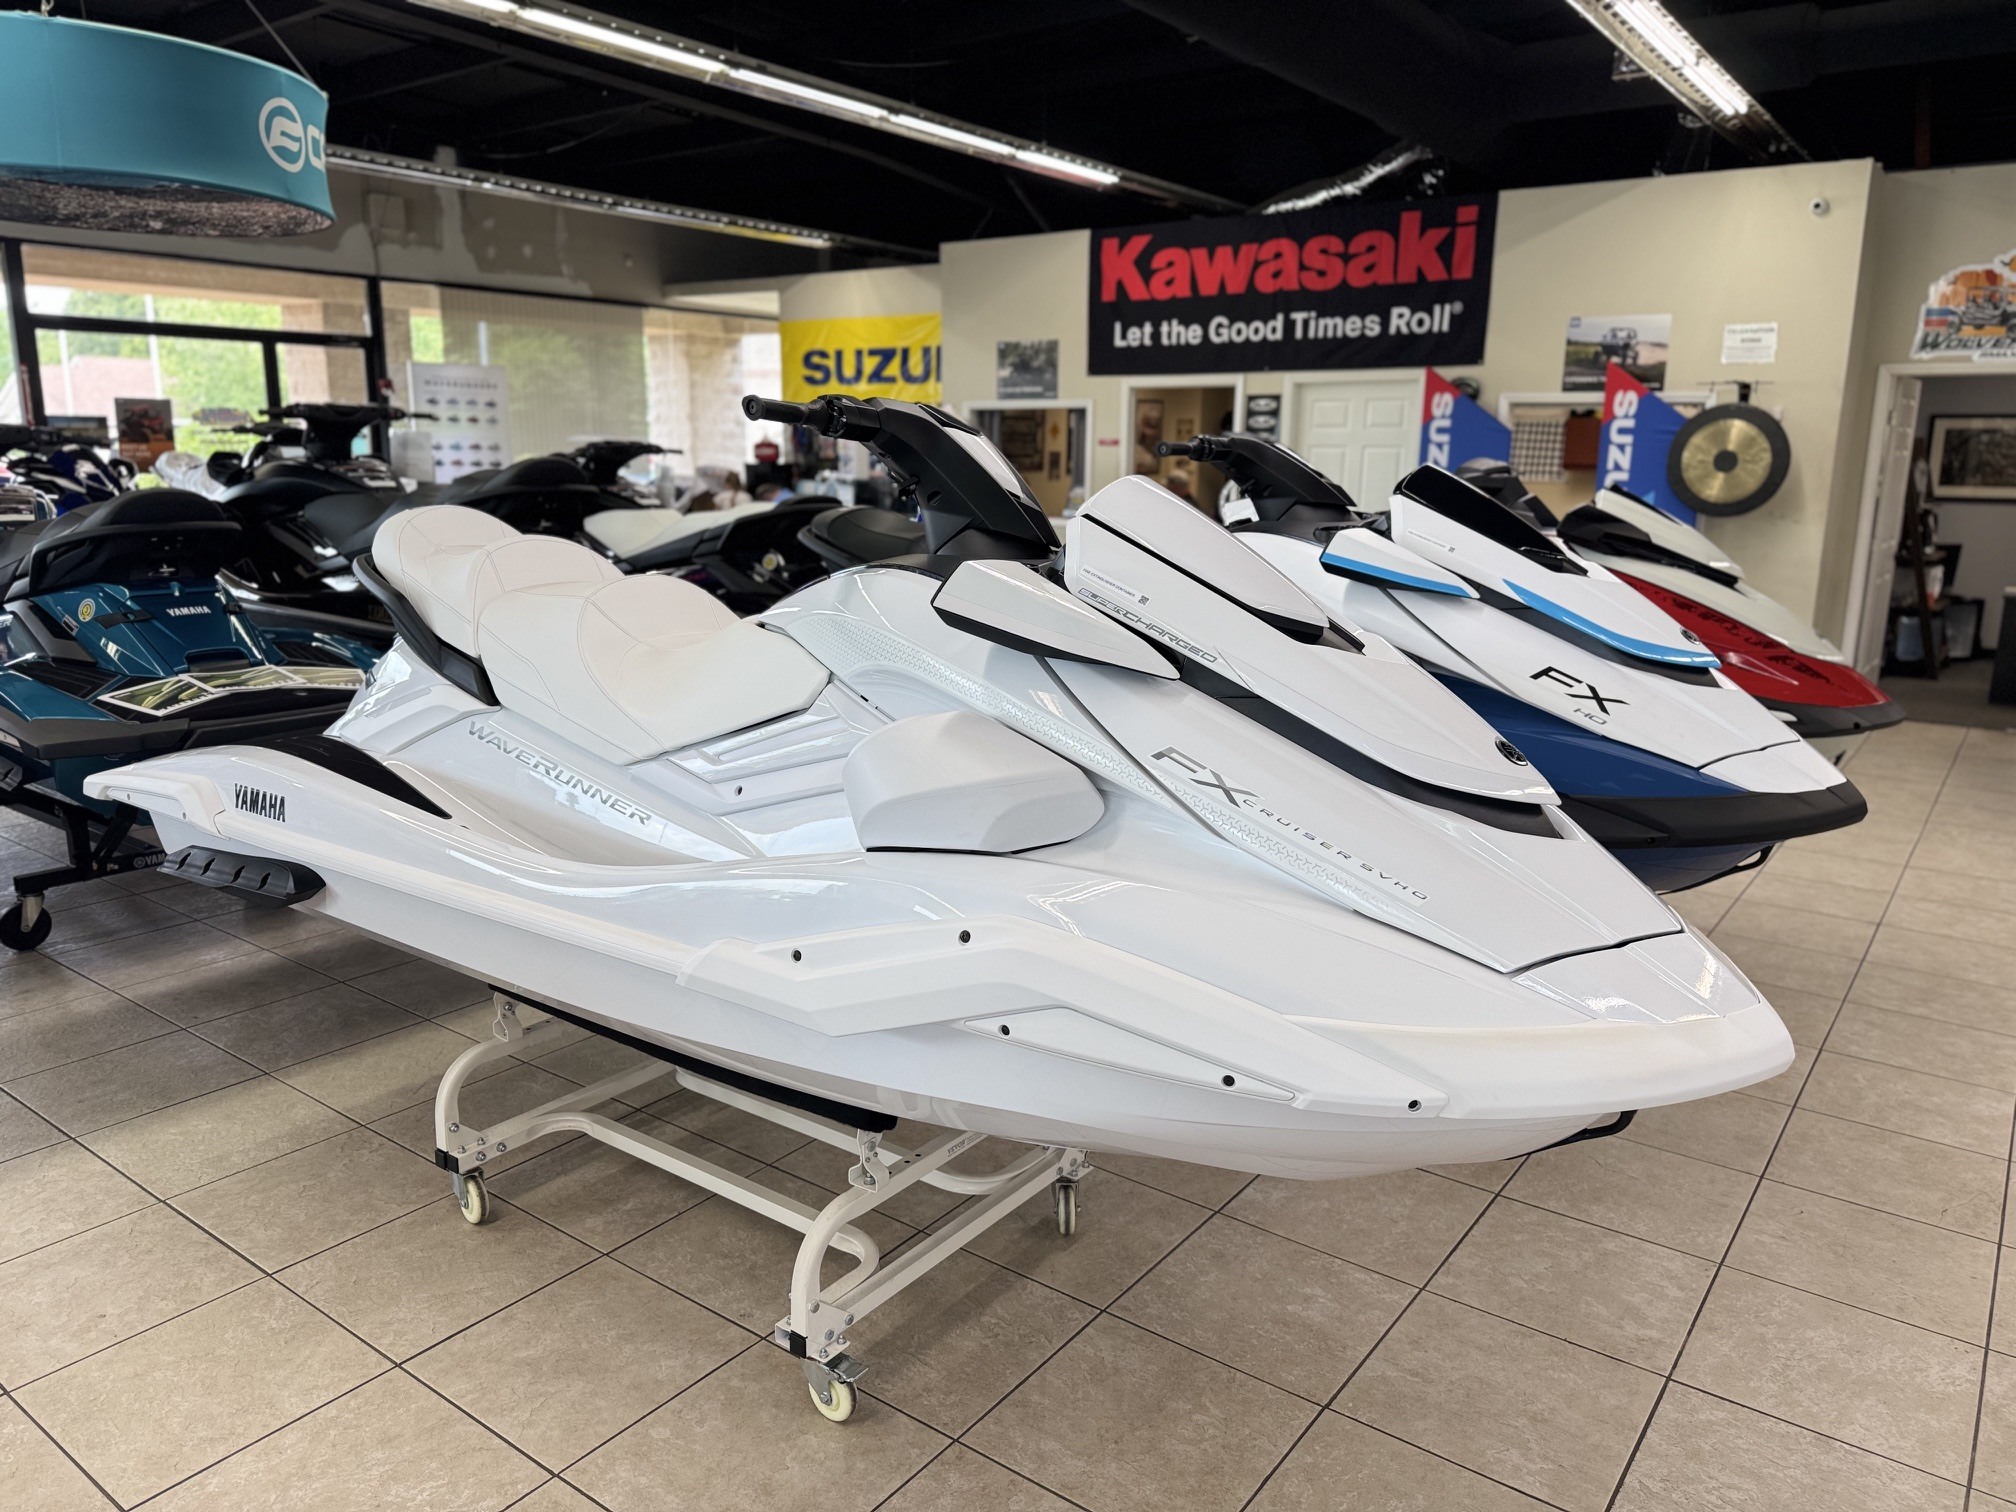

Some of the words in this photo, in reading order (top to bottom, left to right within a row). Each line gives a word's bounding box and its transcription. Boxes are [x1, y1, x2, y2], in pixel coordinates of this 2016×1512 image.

[306, 124, 326, 172] C
[1100, 204, 1480, 303] Kawasaki
[1113, 320, 1153, 348] Let
[1160, 318, 1203, 347] the
[1208, 312, 1284, 344] Good
[1289, 310, 1381, 340] Times
[802, 345, 942, 386] SUZU
[166, 605, 211, 617] YAMAHA
[1077, 587, 1218, 664] SUPERCHARGED
[1528, 665, 1631, 716] FX
[1573, 708, 1607, 725] HO
[468, 720, 652, 826] WAVERUNNER
[234, 782, 286, 823] YAMAHA
[1150, 746, 1260, 809] FX
[1242, 799, 1352, 860] CRUISER
[1359, 862, 1428, 901] SVHO
